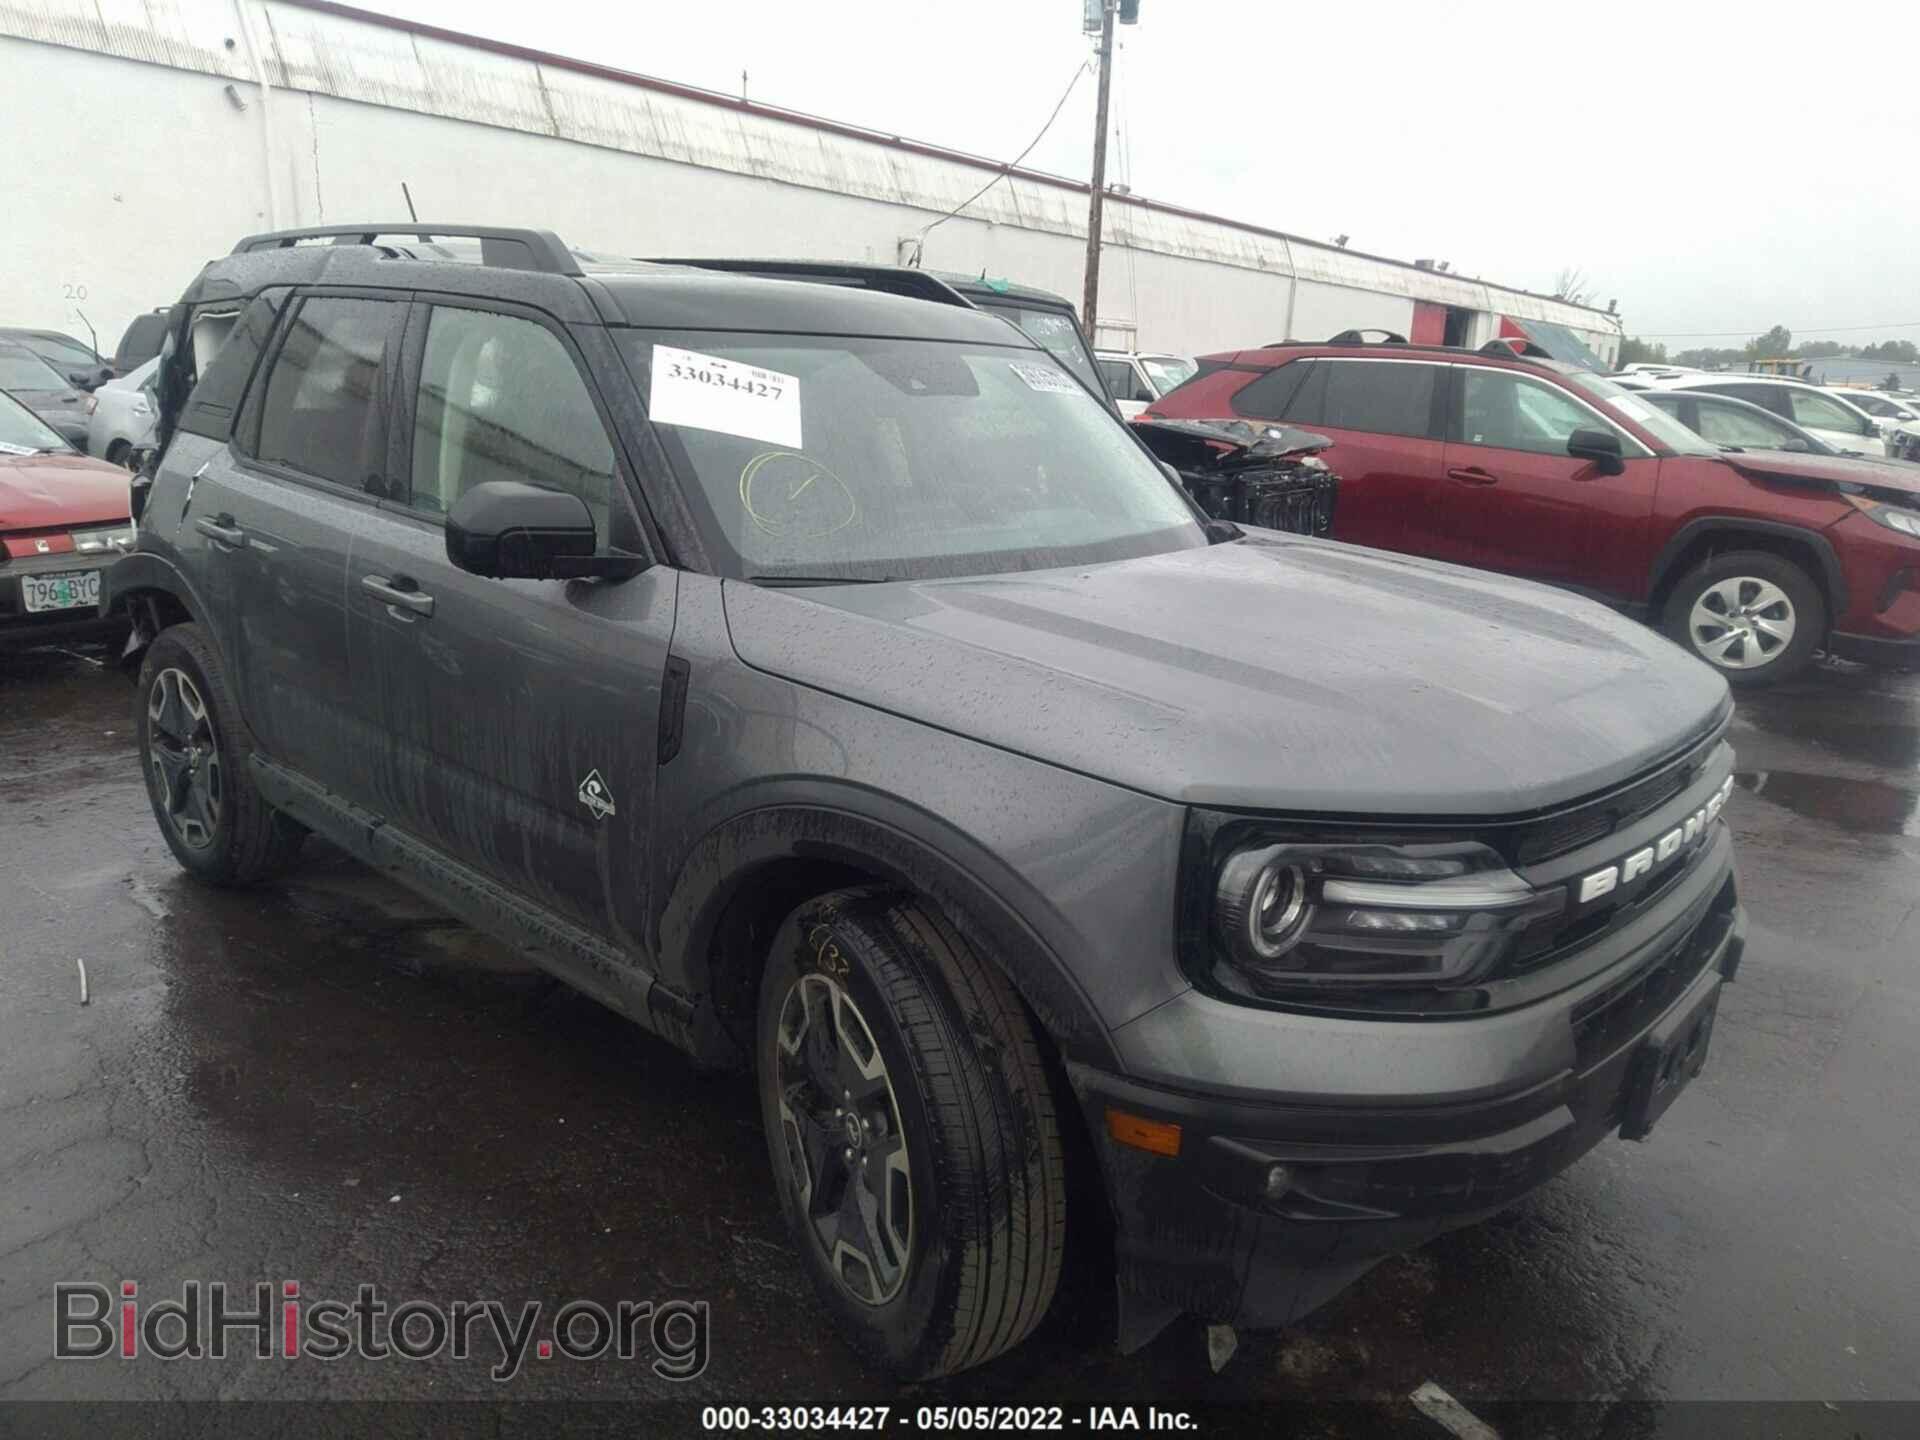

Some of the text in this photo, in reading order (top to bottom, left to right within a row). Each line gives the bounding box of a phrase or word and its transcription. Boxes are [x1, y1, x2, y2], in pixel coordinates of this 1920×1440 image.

[667, 363, 783, 401] 33034427
[26, 578, 98, 602] 796 BYC
